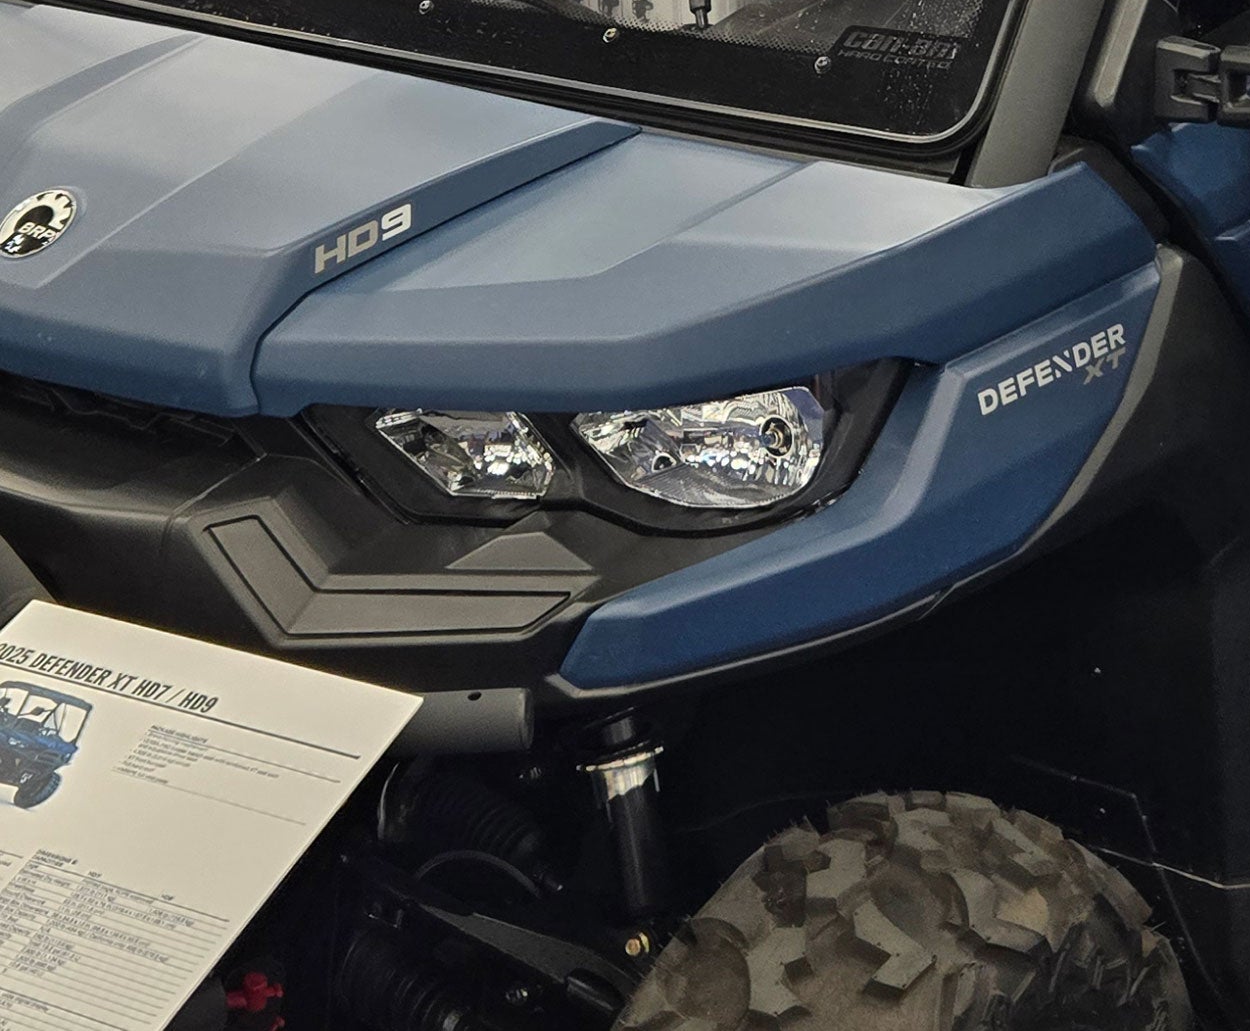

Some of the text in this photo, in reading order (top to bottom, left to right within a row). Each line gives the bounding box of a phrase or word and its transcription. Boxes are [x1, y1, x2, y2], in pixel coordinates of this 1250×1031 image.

[843, 30, 961, 60] can-am
[18, 221, 57, 240] BRP
[314, 202, 412, 274] HD9
[977, 323, 1127, 416] DEFENDER
[1083, 346, 1127, 386] XT
[0, 642, 35, 665] 2025
[28, 652, 113, 687] DEFENDER
[107, 672, 139, 692] XT
[132, 678, 173, 701] HD7
[178, 690, 219, 714] HD9
